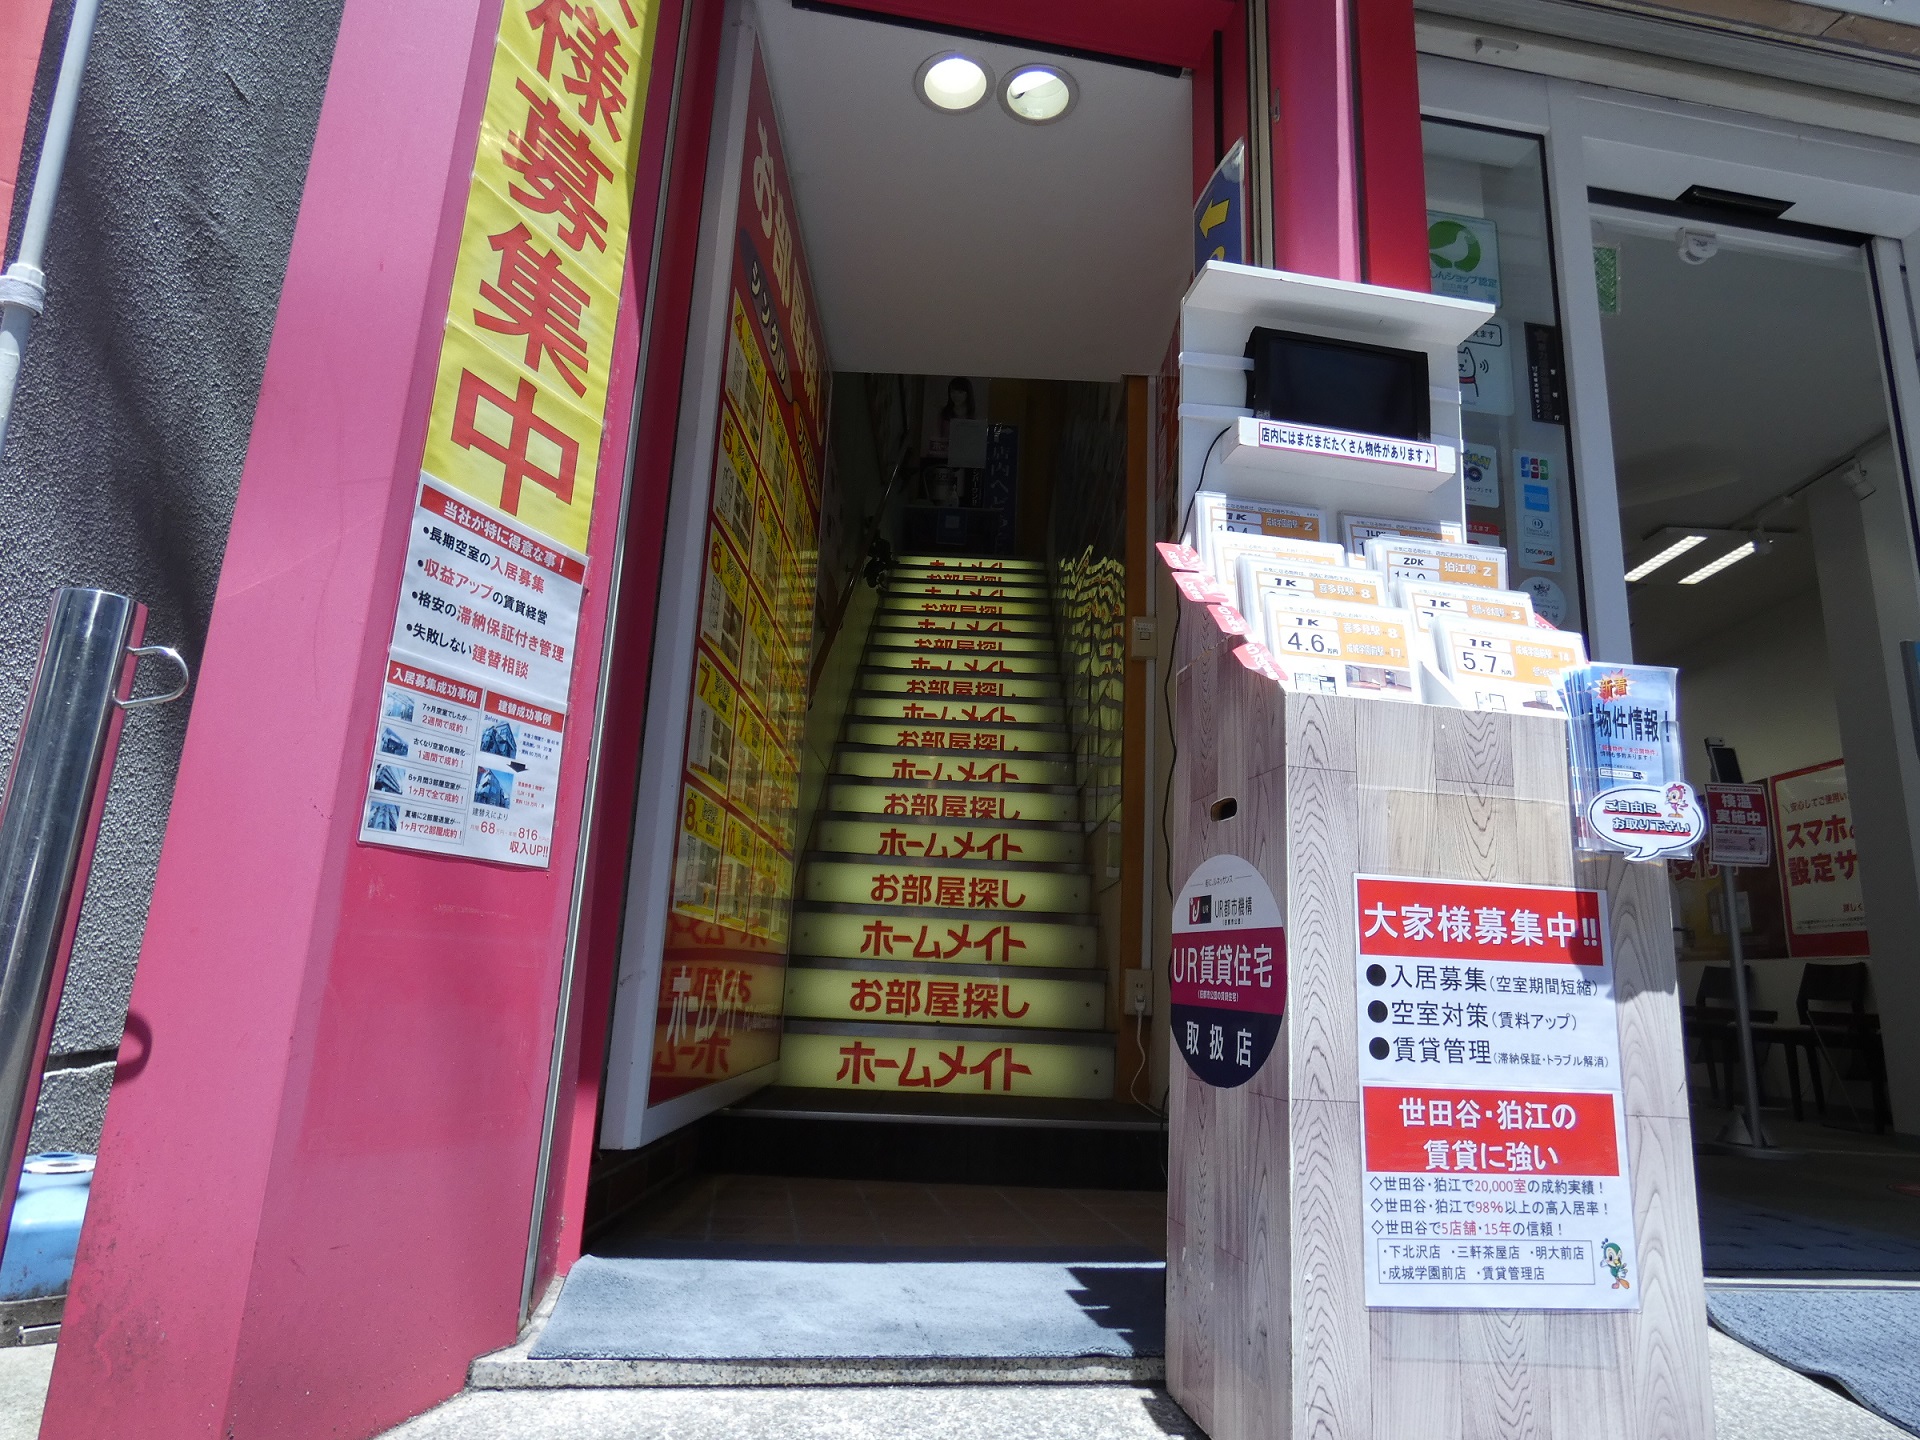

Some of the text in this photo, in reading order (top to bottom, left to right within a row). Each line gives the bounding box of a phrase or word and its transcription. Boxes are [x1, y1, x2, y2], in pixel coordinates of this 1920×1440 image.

[451, 0, 637, 516] 様募集中
[1226, 512, 1247, 521] 1K
[444, 501, 565, 572] 当社が特に得意な事！
[1525, 548, 1553, 556] DISCOVER
[429, 528, 544, 593] 長期空室の入居募集
[423, 558, 548, 625] 収益アップの賃貸経営
[1274, 578, 1297, 587] 1K
[1430, 599, 1451, 608] 1K
[1511, 610, 1521, 620] 3
[417, 590, 564, 663] 格安の滞納保証付き管理
[1287, 632, 1325, 653] 4.6
[1296, 617, 1319, 626] 1K
[1388, 628, 1399, 638] 8
[412, 623, 529, 680] 失敗しない建替相談
[1390, 648, 1402, 659] 17
[1469, 638, 1493, 649] 1R
[1462, 652, 1497, 673] 5.7
[392, 668, 477, 704] 入居募集成功事例
[906, 680, 1017, 698] お部屋探し
[1599, 677, 1628, 697] 新着
[497, 699, 551, 726] 建替成功事例
[902, 703, 1018, 722] ホームメイト
[1595, 703, 1670, 743] 物件情報！
[898, 731, 1019, 752] お部屋探し
[892, 759, 1020, 783] ホームメイト
[884, 793, 1021, 821] お部屋探し
[1605, 800, 1658, 814] ご自由に
[1613, 817, 1691, 833] お取り下さい
[877, 828, 1024, 861] ホームメイト
[870, 874, 1027, 909] お部屋探し
[1215, 896, 1252, 918] UR都市機構
[1364, 901, 1598, 948] 大家様募集中!!
[860, 920, 1028, 963] ホームメイト
[1173, 944, 1273, 988] UR賃貸住宅
[1391, 965, 1598, 997] 入居募集(空室期間短縮)
[666, 965, 743, 1047] ホームメイト
[850, 979, 1030, 1019] お部屋探し
[1391, 1000, 1577, 1031] 空室対策(賃料アップ)
[1186, 1021, 1252, 1068] 取扱店
[1393, 1036, 1609, 1068] 賃貸管理(滞納保証・トラブル解消)
[836, 1040, 1032, 1092] ホームメイト
[1399, 1097, 1576, 1130] 世田谷・狛江の
[1423, 1139, 1558, 1172] 賃貸に強い
